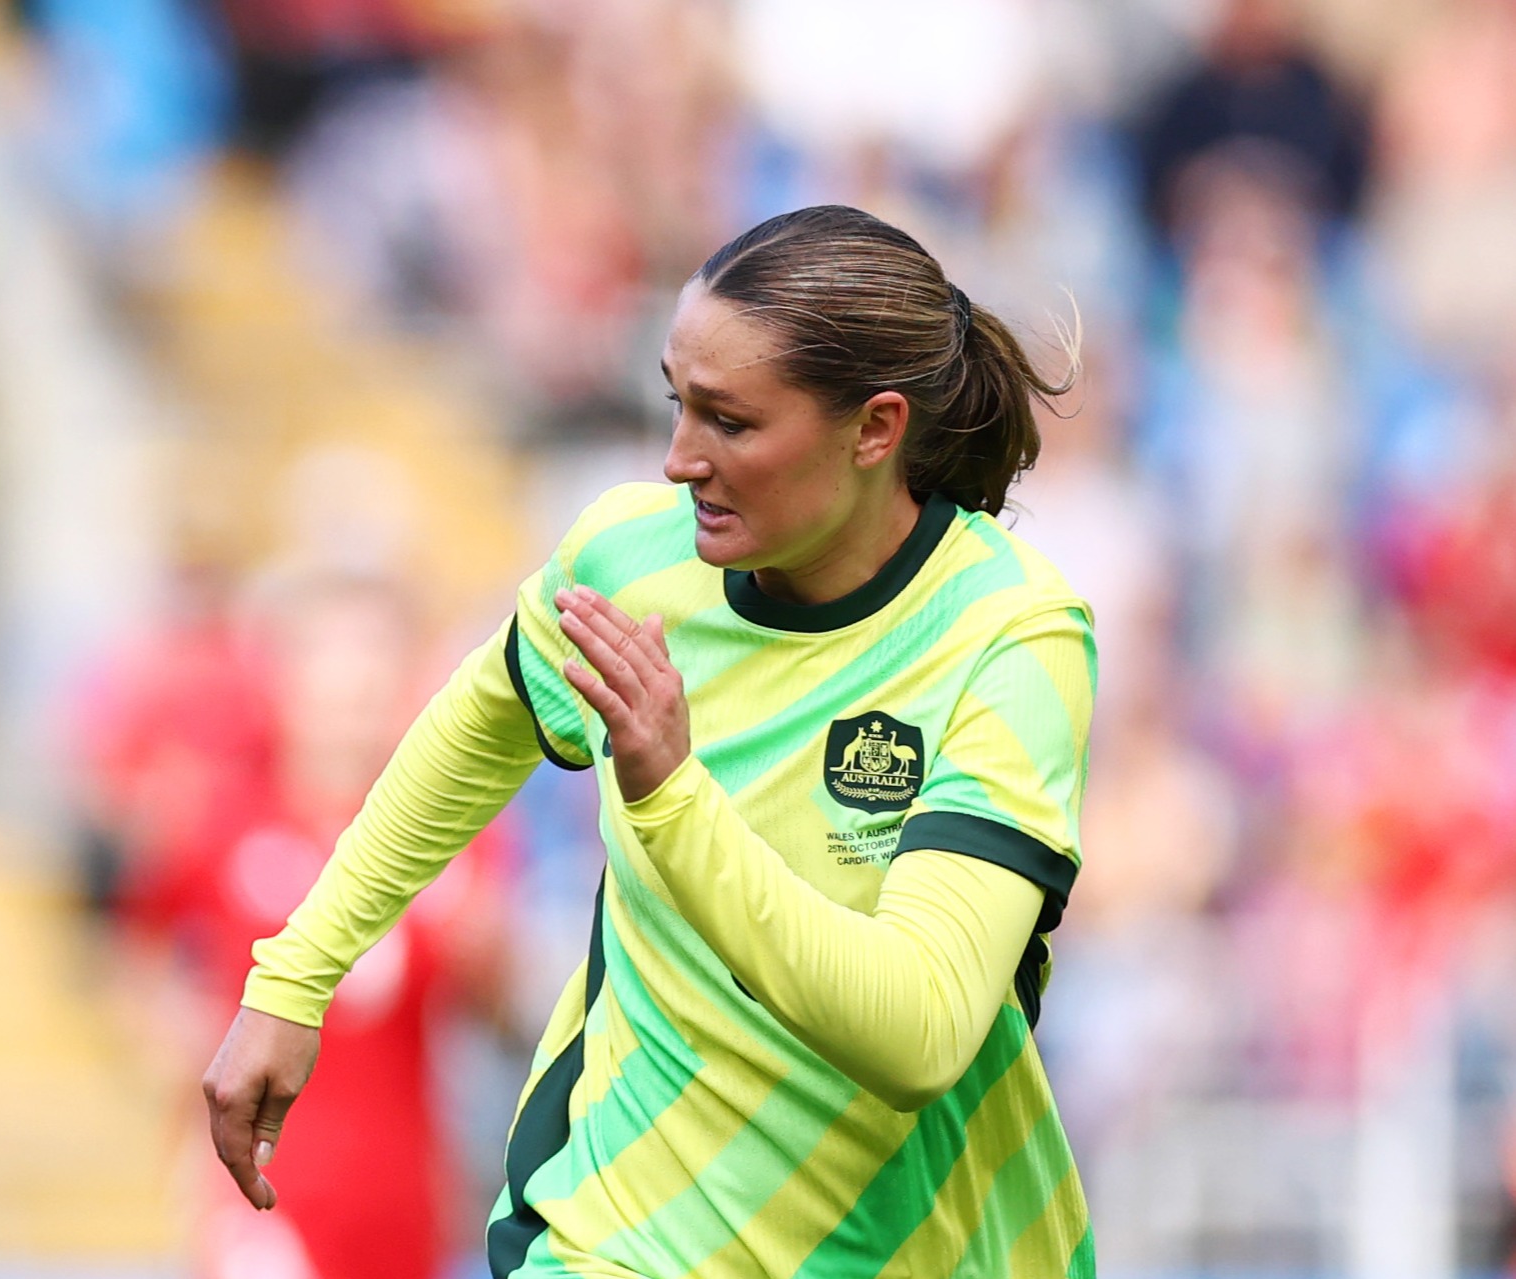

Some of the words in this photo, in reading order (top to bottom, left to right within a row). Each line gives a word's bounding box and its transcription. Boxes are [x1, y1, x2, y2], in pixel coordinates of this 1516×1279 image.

[841, 772, 908, 787] AUSTRALIA
[826, 832, 855, 841] WALES
[856, 831, 864, 839] V
[866, 822, 903, 838] AUSTRA
[827, 844, 848, 853] 25TH
[849, 837, 898, 852] OCTOBER
